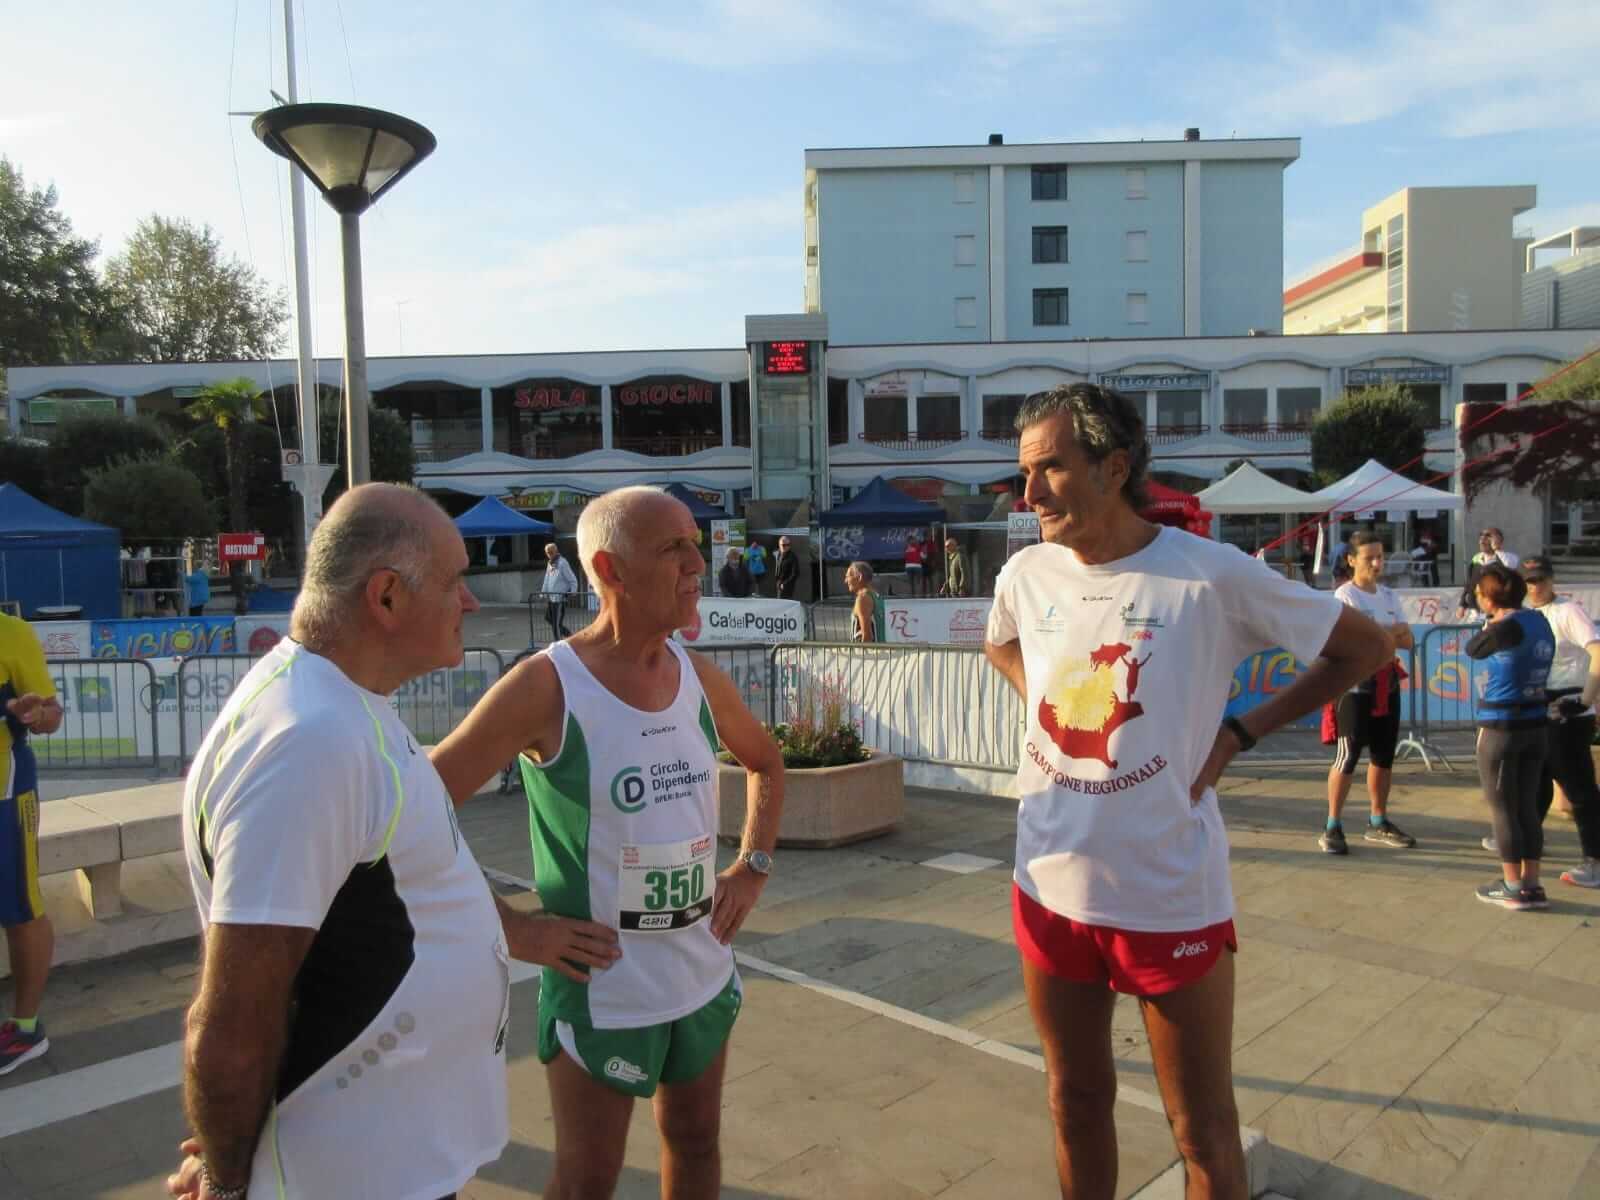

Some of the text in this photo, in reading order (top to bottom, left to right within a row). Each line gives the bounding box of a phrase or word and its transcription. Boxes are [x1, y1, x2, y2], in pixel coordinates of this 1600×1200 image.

[513, 382, 713, 409] SALA GIOCHI
[650, 760, 689, 777] Circolo
[652, 769, 710, 792] Dipendenti
[1026, 741, 1167, 795] CAMPIONE REGIONALE
[644, 863, 704, 911] 350
